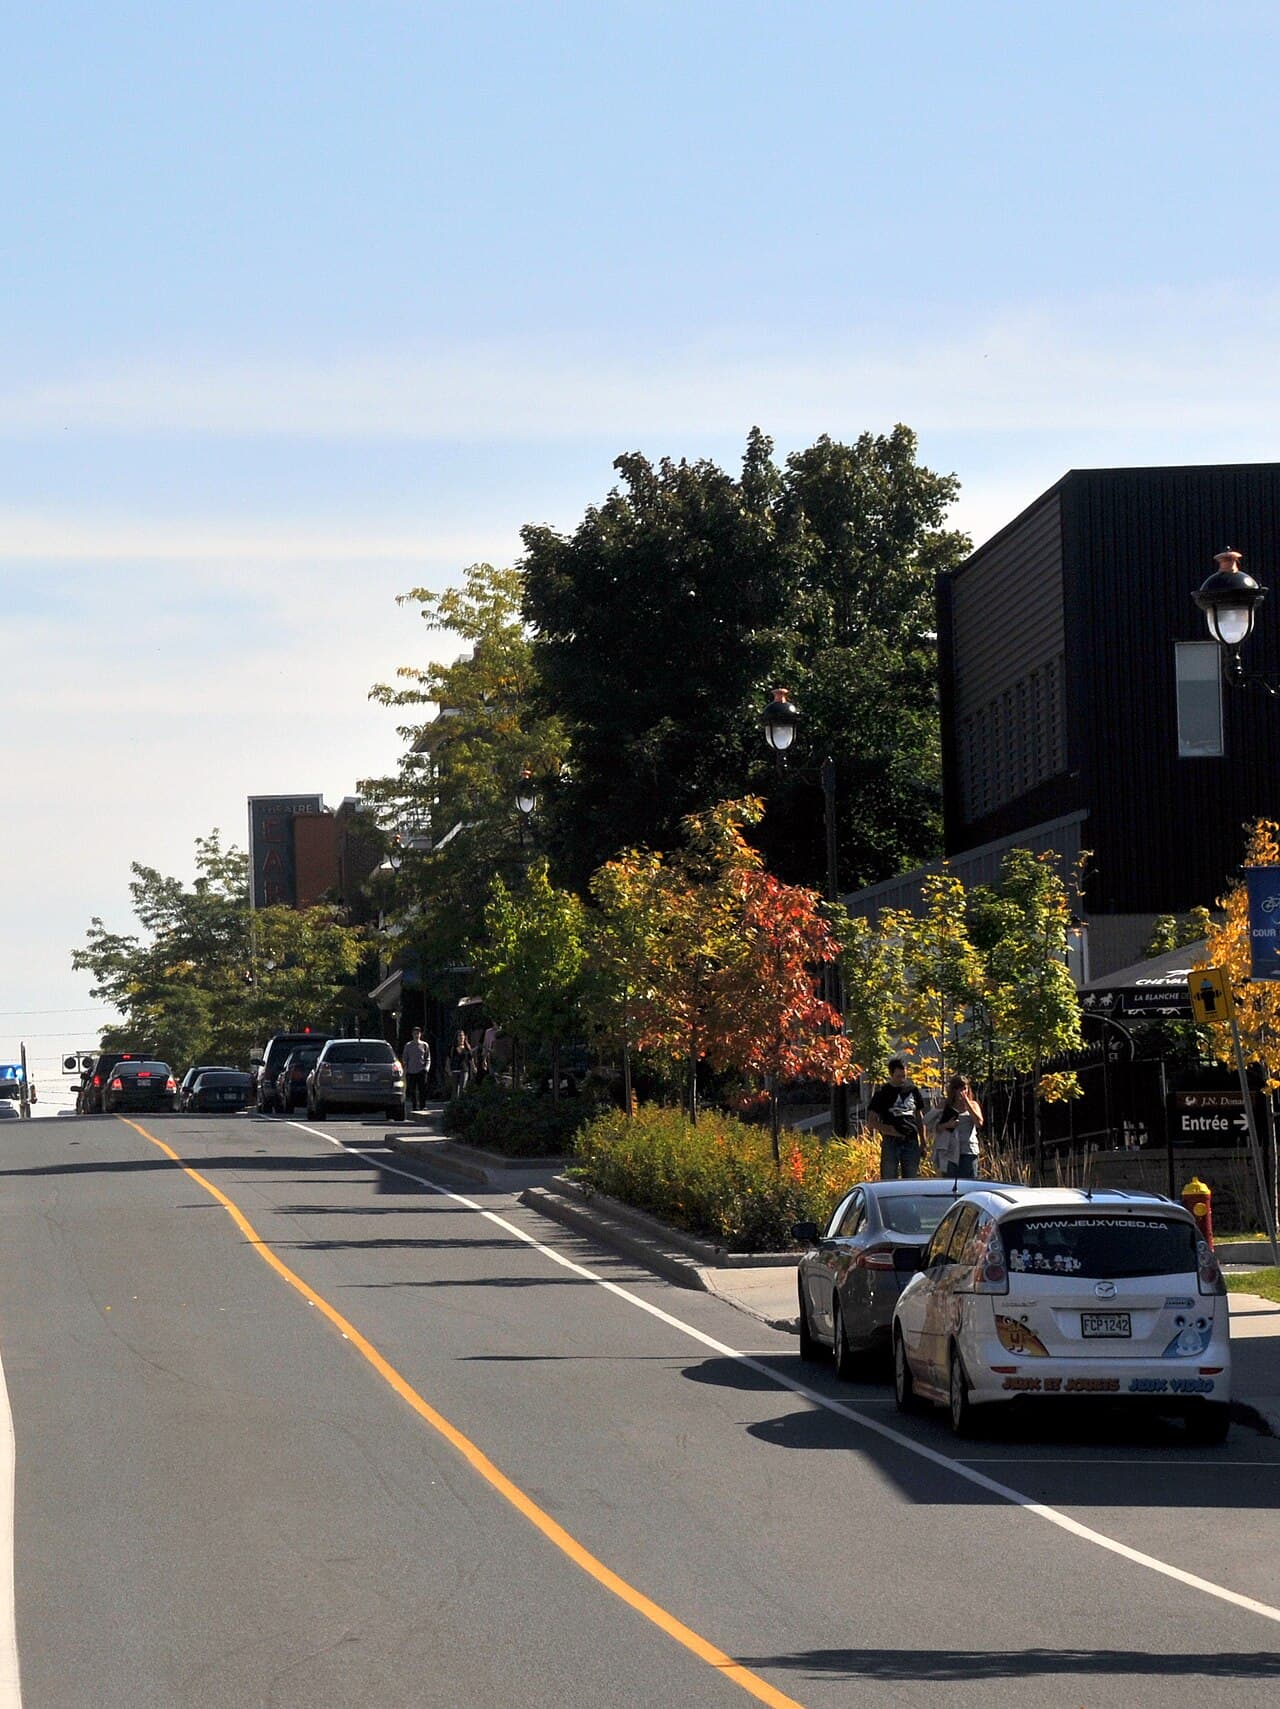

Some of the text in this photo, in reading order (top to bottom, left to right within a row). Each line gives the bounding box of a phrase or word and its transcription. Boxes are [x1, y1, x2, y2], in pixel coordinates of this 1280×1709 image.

[1253, 928, 1277, 937] COUR
[1145, 991, 1180, 1000] BLANCHE
[1181, 1114, 1229, 1130] Entrée
[1025, 1219, 1168, 1230] WWW.JEUXVIDEO.CA
[1083, 1318, 1129, 1332] FCP1242
